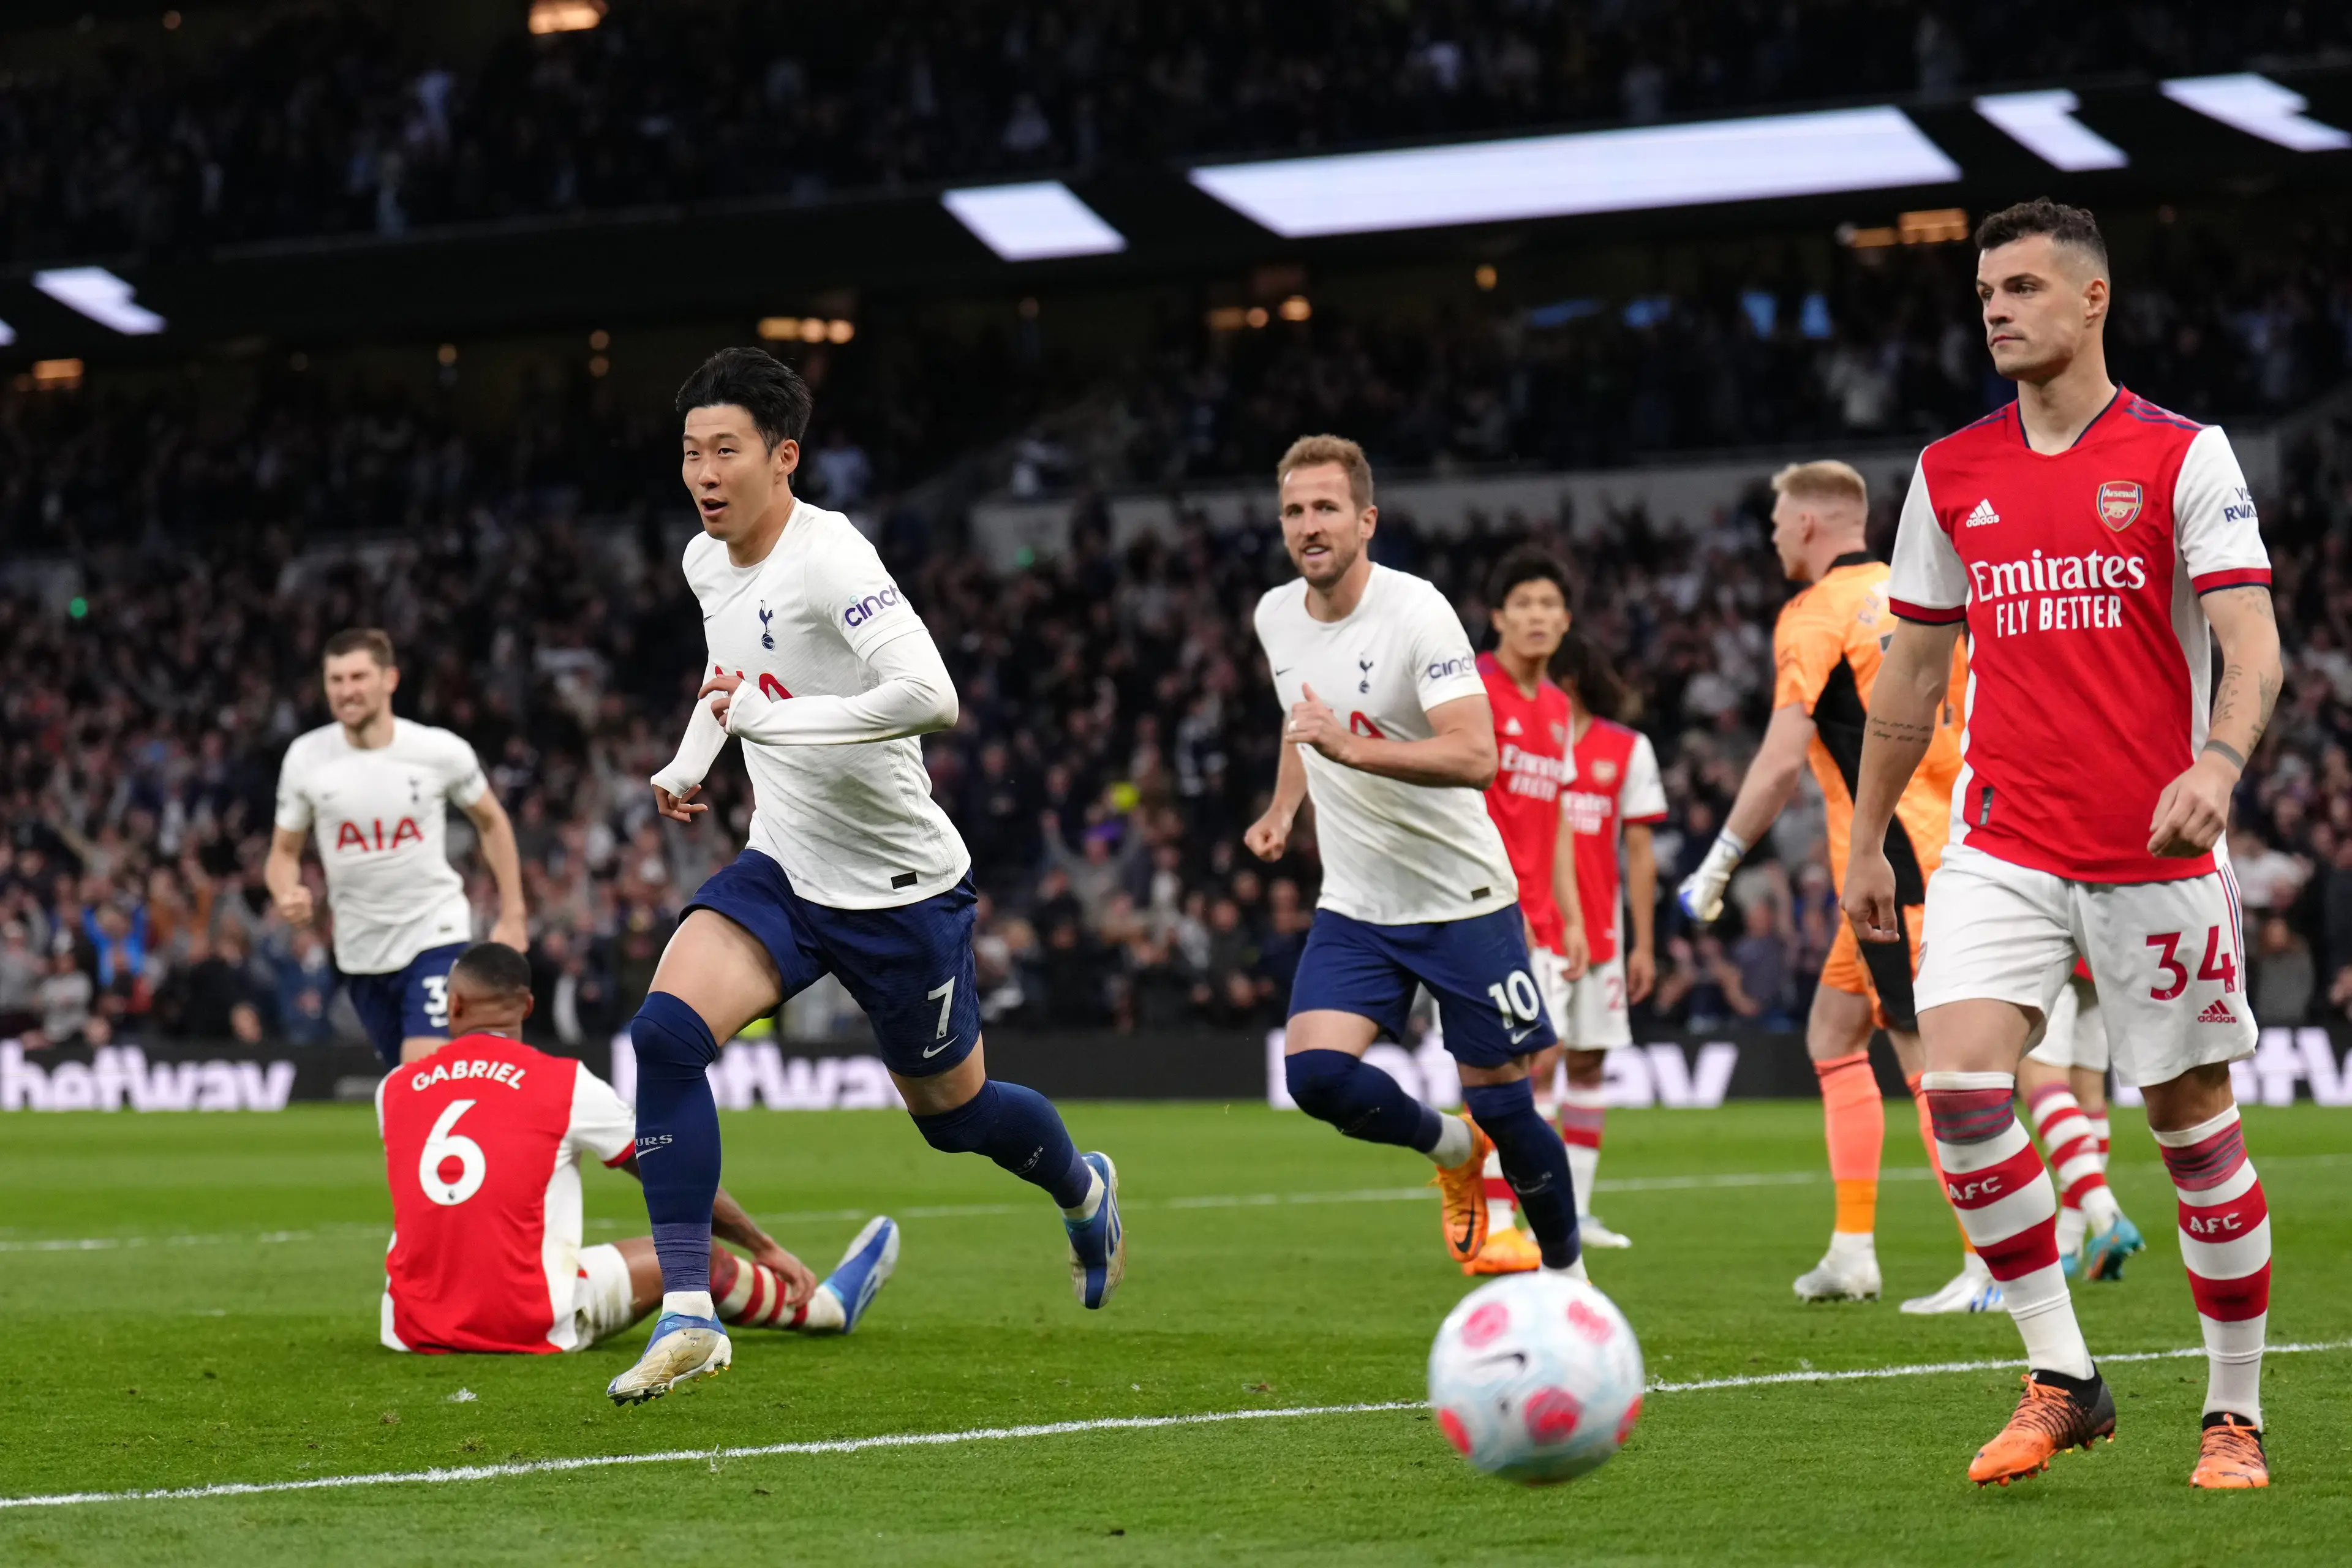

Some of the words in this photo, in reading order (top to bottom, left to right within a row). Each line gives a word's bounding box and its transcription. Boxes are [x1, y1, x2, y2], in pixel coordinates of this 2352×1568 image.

[1966, 514, 2000, 528] adidas
[1970, 549, 2146, 603] Emirates
[845, 584, 907, 627] cinch
[1996, 599, 2029, 638] FLY
[2039, 595, 2122, 631] BETTER
[336, 816, 424, 853] AIA
[2146, 925, 2236, 1001] 34
[927, 975, 956, 1040] 7
[1488, 970, 1540, 1030] 10
[2197, 1014, 2237, 1023] adidas
[411, 1060, 526, 1091] GABRIEL
[419, 1099, 486, 1206] 6
[636, 1134, 673, 1146] URS
[1948, 1176, 2002, 1200] AFC
[2190, 1213, 2242, 1234] AFC
